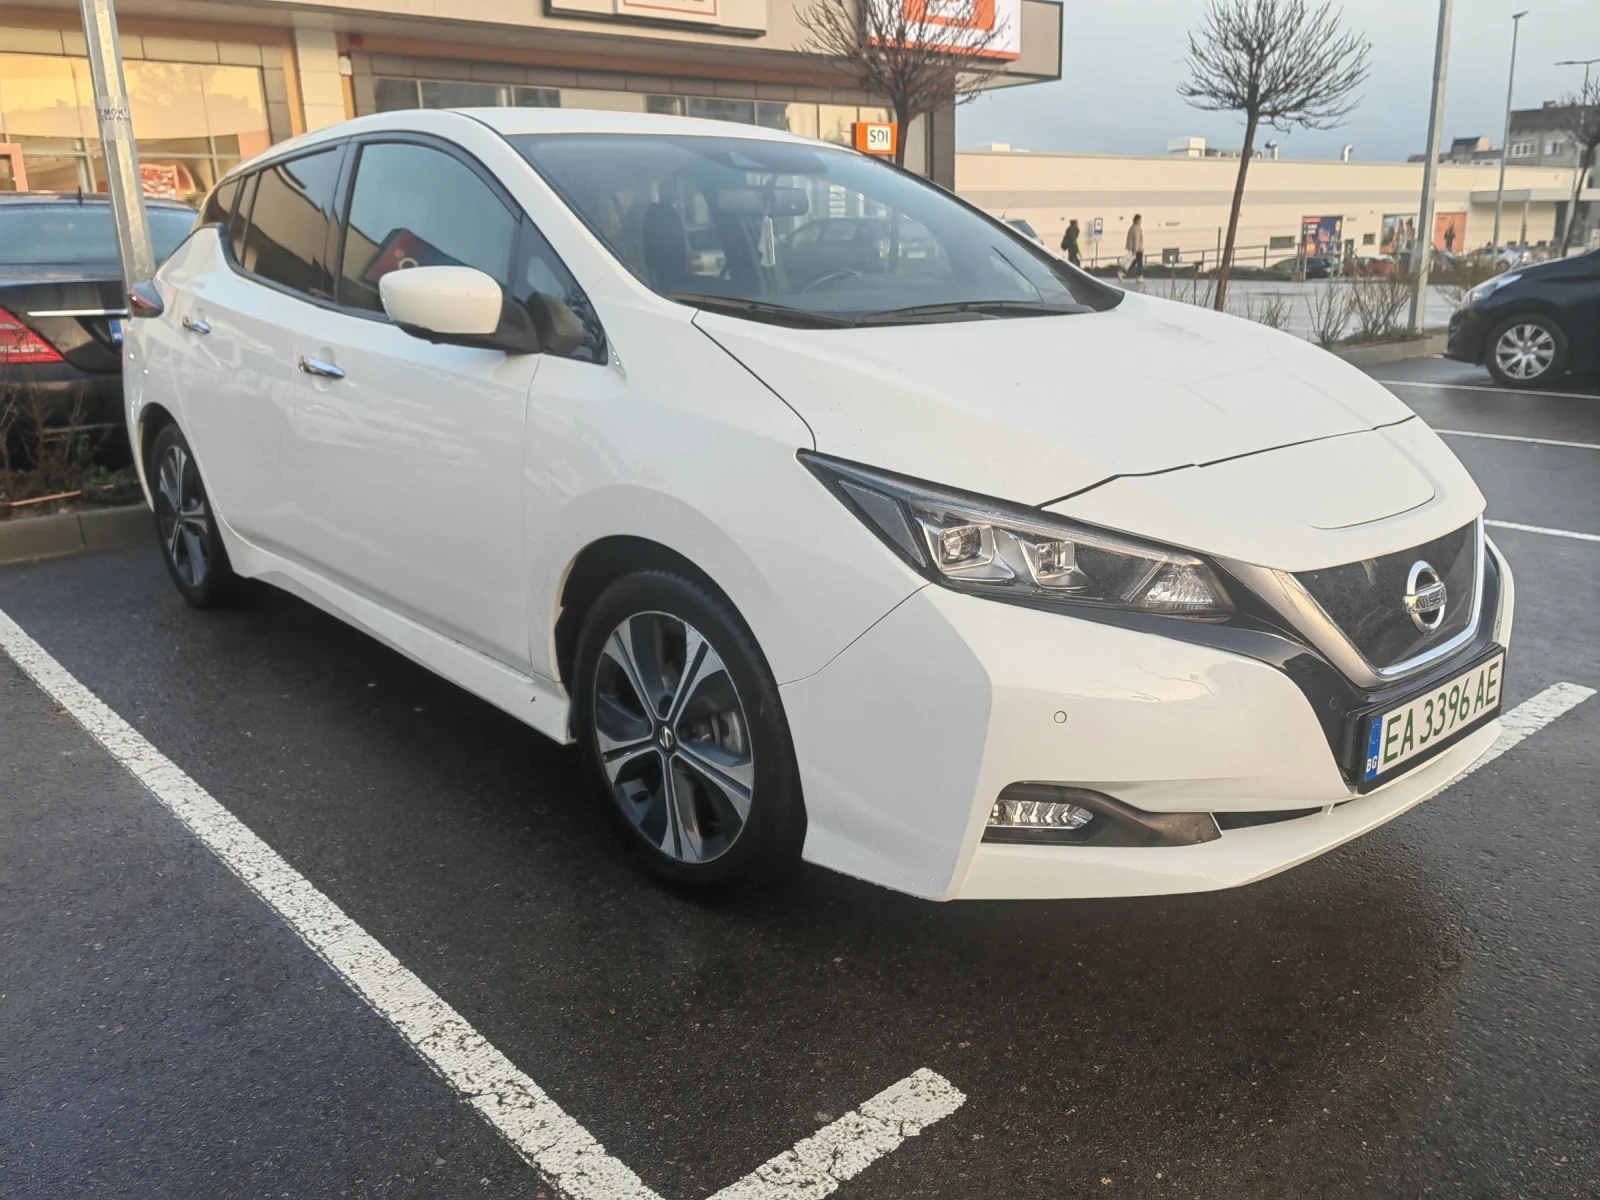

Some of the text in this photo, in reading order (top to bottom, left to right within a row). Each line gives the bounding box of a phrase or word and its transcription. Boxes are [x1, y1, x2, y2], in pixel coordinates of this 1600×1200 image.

[869, 129, 889, 144] SDI
[1383, 661, 1500, 765] EA 3396 AE
[1366, 756, 1378, 772] BG
